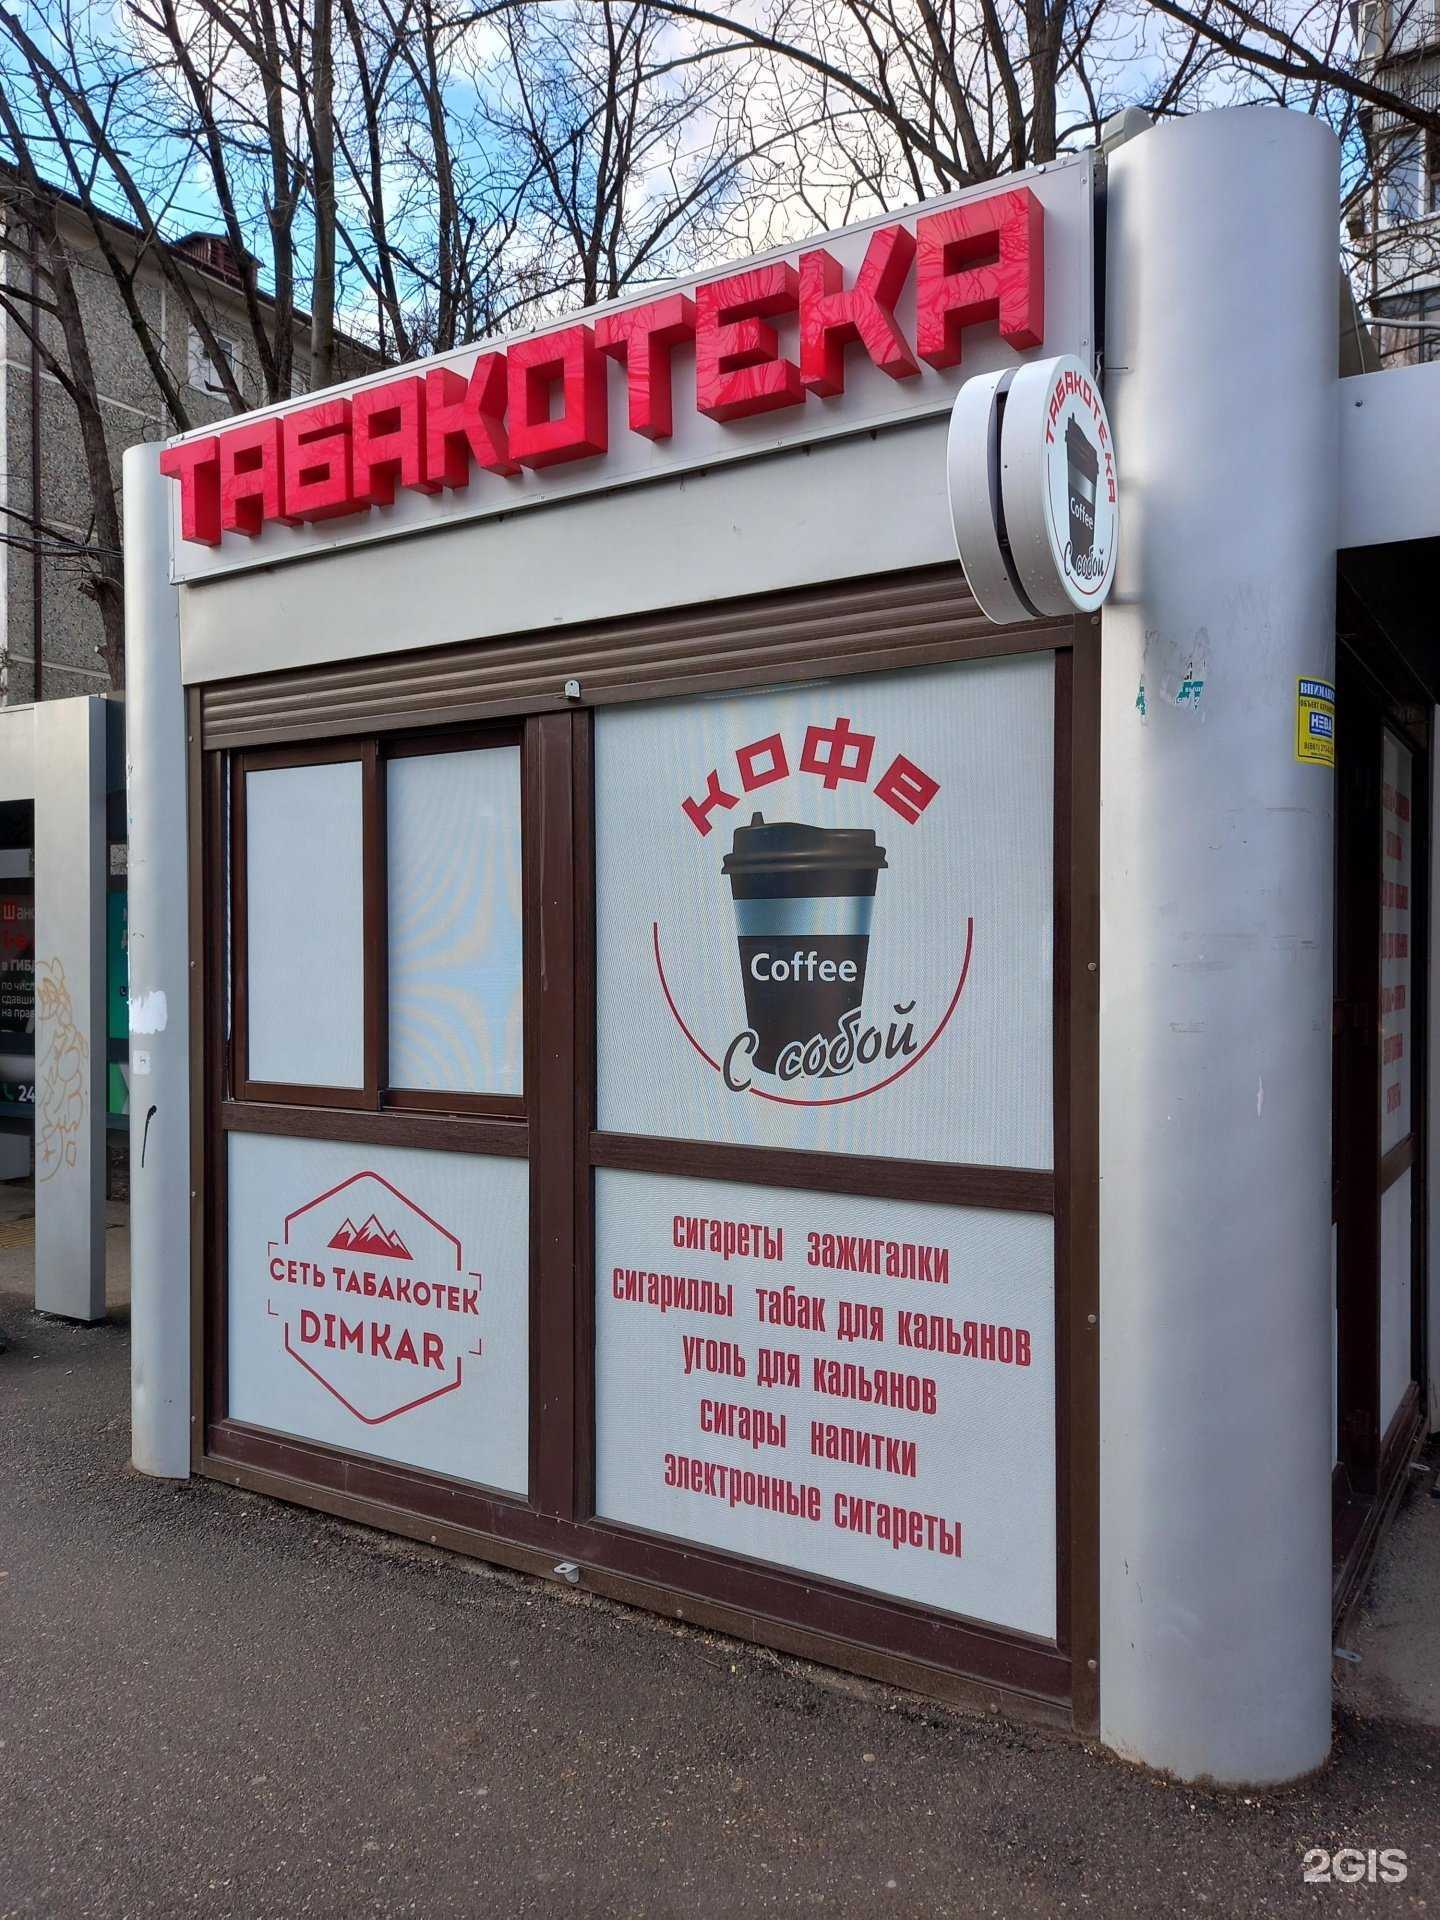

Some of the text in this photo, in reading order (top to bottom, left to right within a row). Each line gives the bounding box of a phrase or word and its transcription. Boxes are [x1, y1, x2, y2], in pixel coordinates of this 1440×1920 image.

[160, 186, 1043, 545] ТАБАКОТЕКА
[1046, 370, 1116, 503] ТАБАКОТЕКА
[1070, 497, 1094, 530] Coffee
[1076, 546, 1105, 580] собой
[682, 717, 941, 837] КОФЕ
[750, 951, 858, 982] Coffee
[2, 1008, 12, 1018] на
[723, 1000, 918, 1092] С собой
[270, 1258, 479, 1315] СЕТЬ ТАБАКОТЕК
[673, 1215, 949, 1284] сигареты зажигалки
[300, 1309, 445, 1371] DIMKAR
[612, 1267, 1031, 1366] сигариллы табак для кальянов
[682, 1335, 937, 1415] уголь для кальянов
[700, 1399, 916, 1478] сигары напитки
[664, 1453, 962, 1558] электронные сигареты
